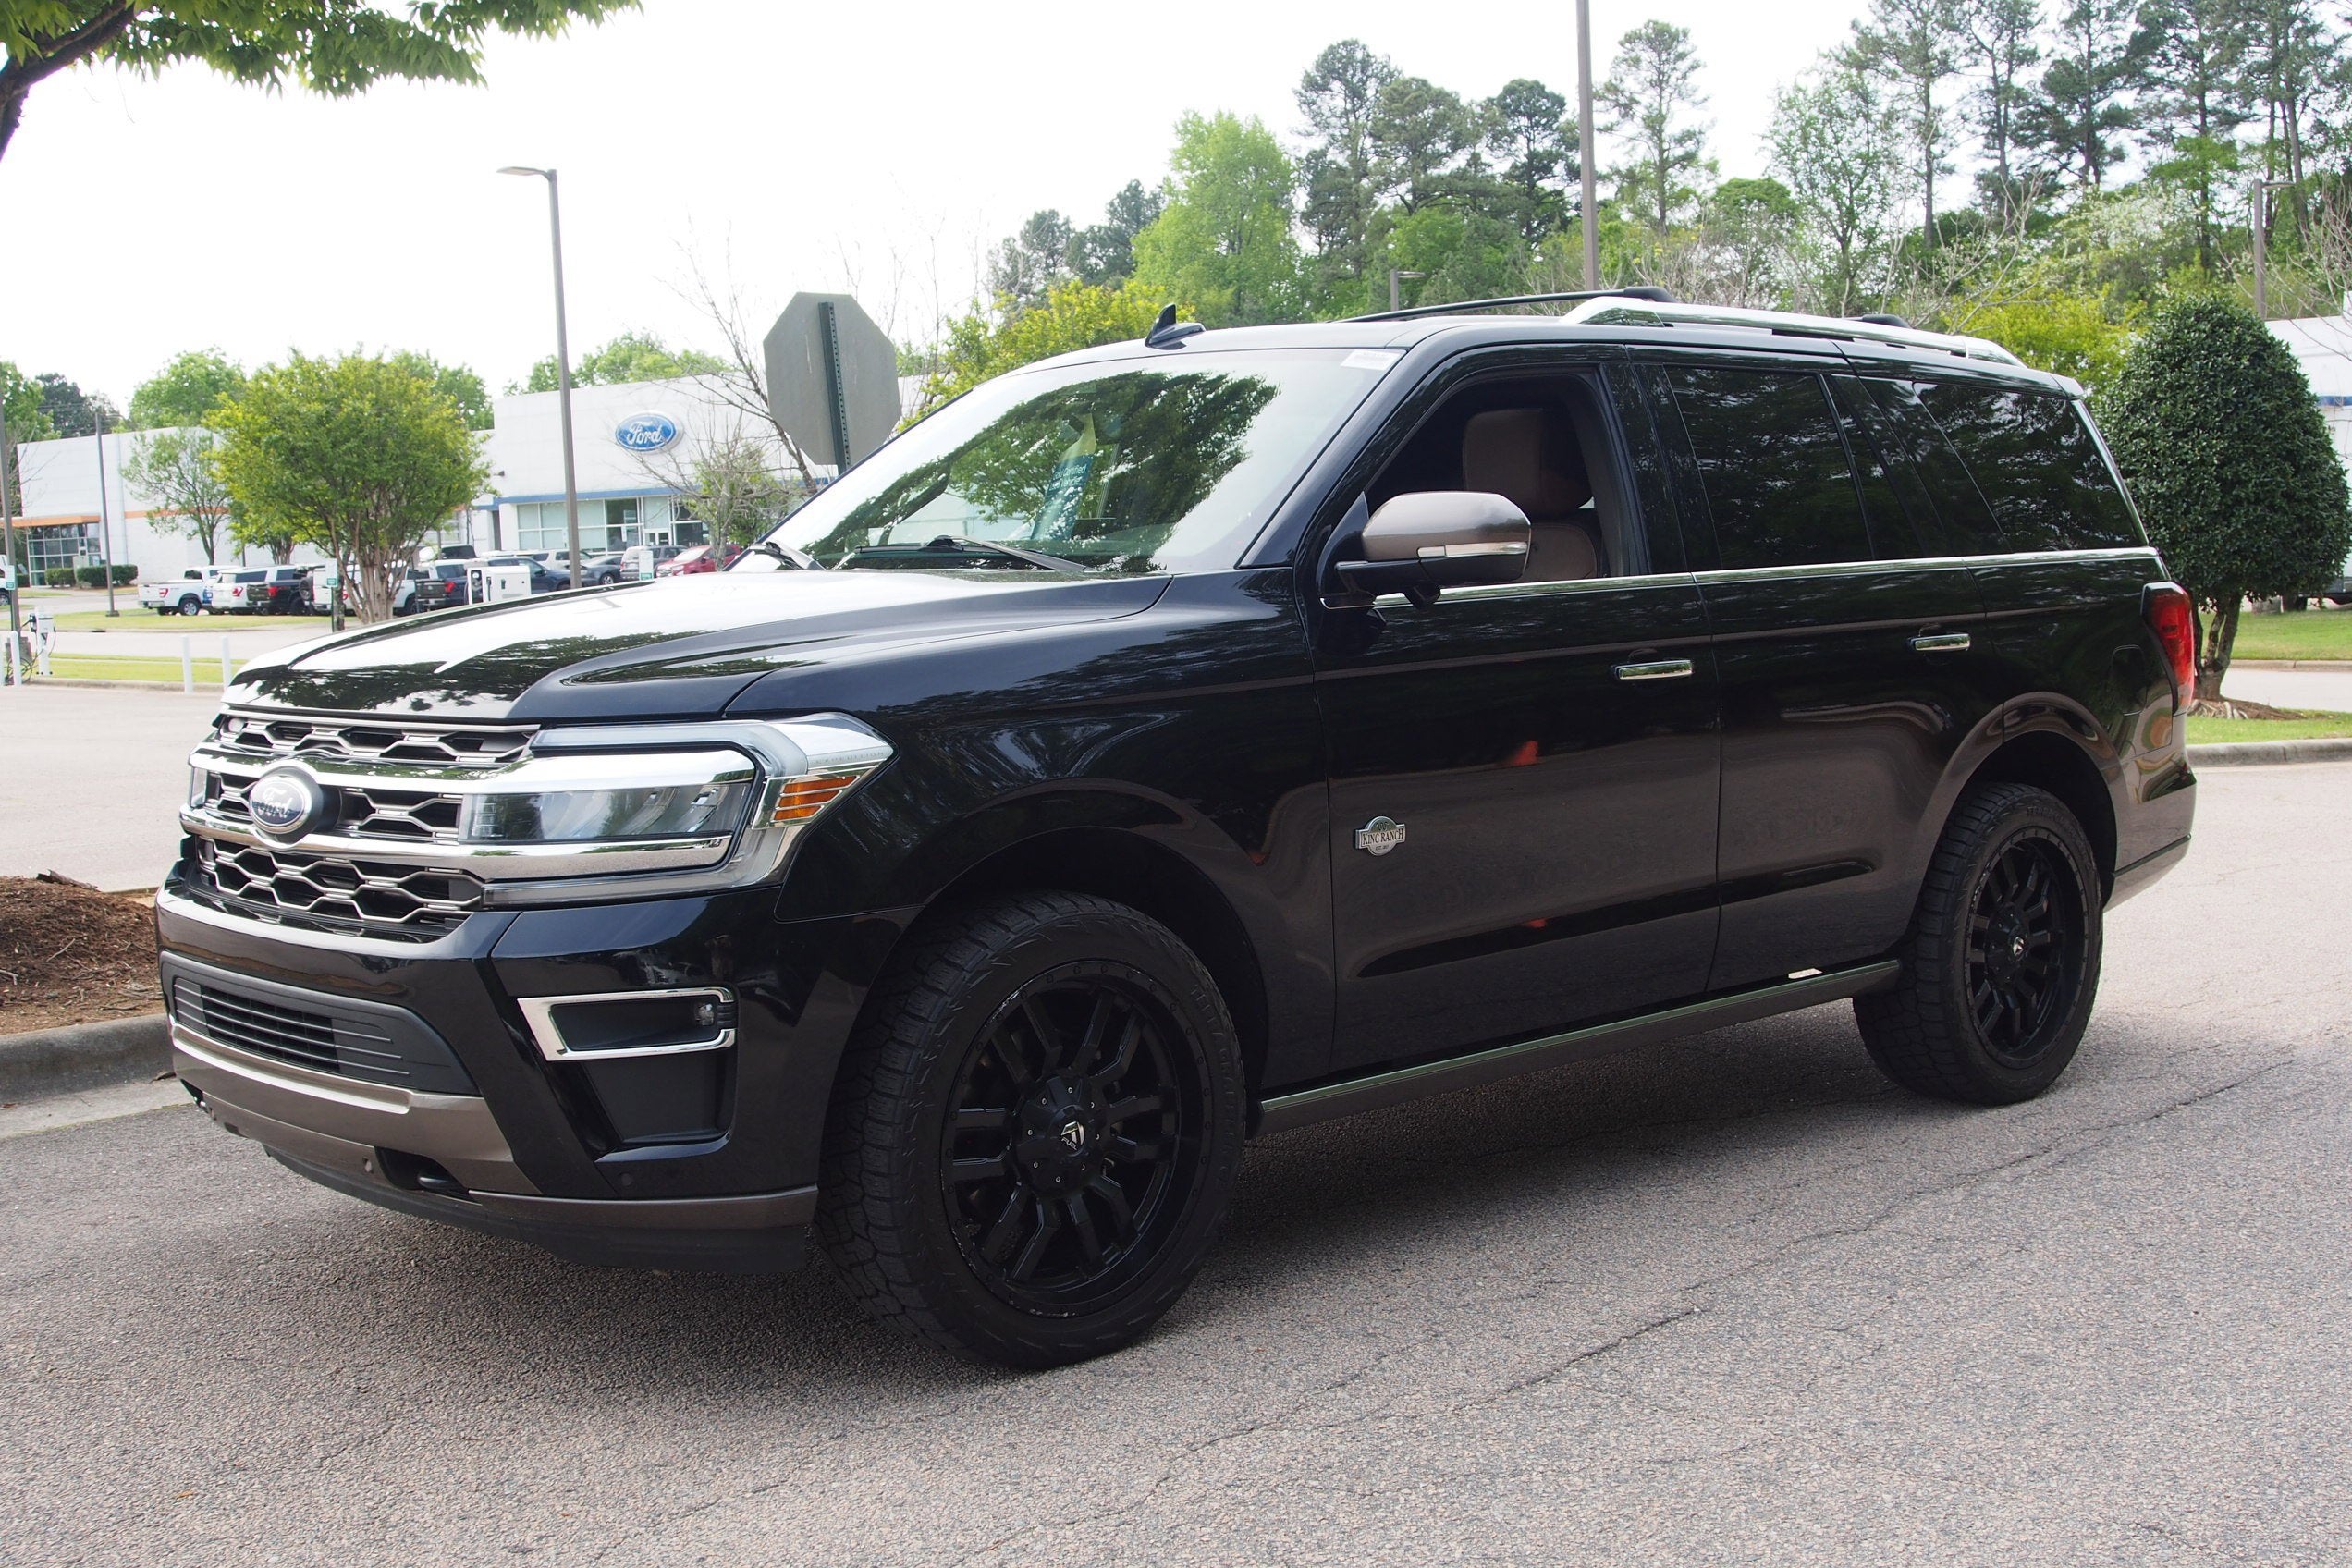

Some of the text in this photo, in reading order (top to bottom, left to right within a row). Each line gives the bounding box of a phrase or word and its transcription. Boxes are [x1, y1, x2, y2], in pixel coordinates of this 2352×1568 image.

[627, 421, 663, 445] Ford
[258, 787, 294, 819] Ford
[1363, 828, 1403, 845] KING RANCH
[1060, 1136, 1078, 1151] FUEL
